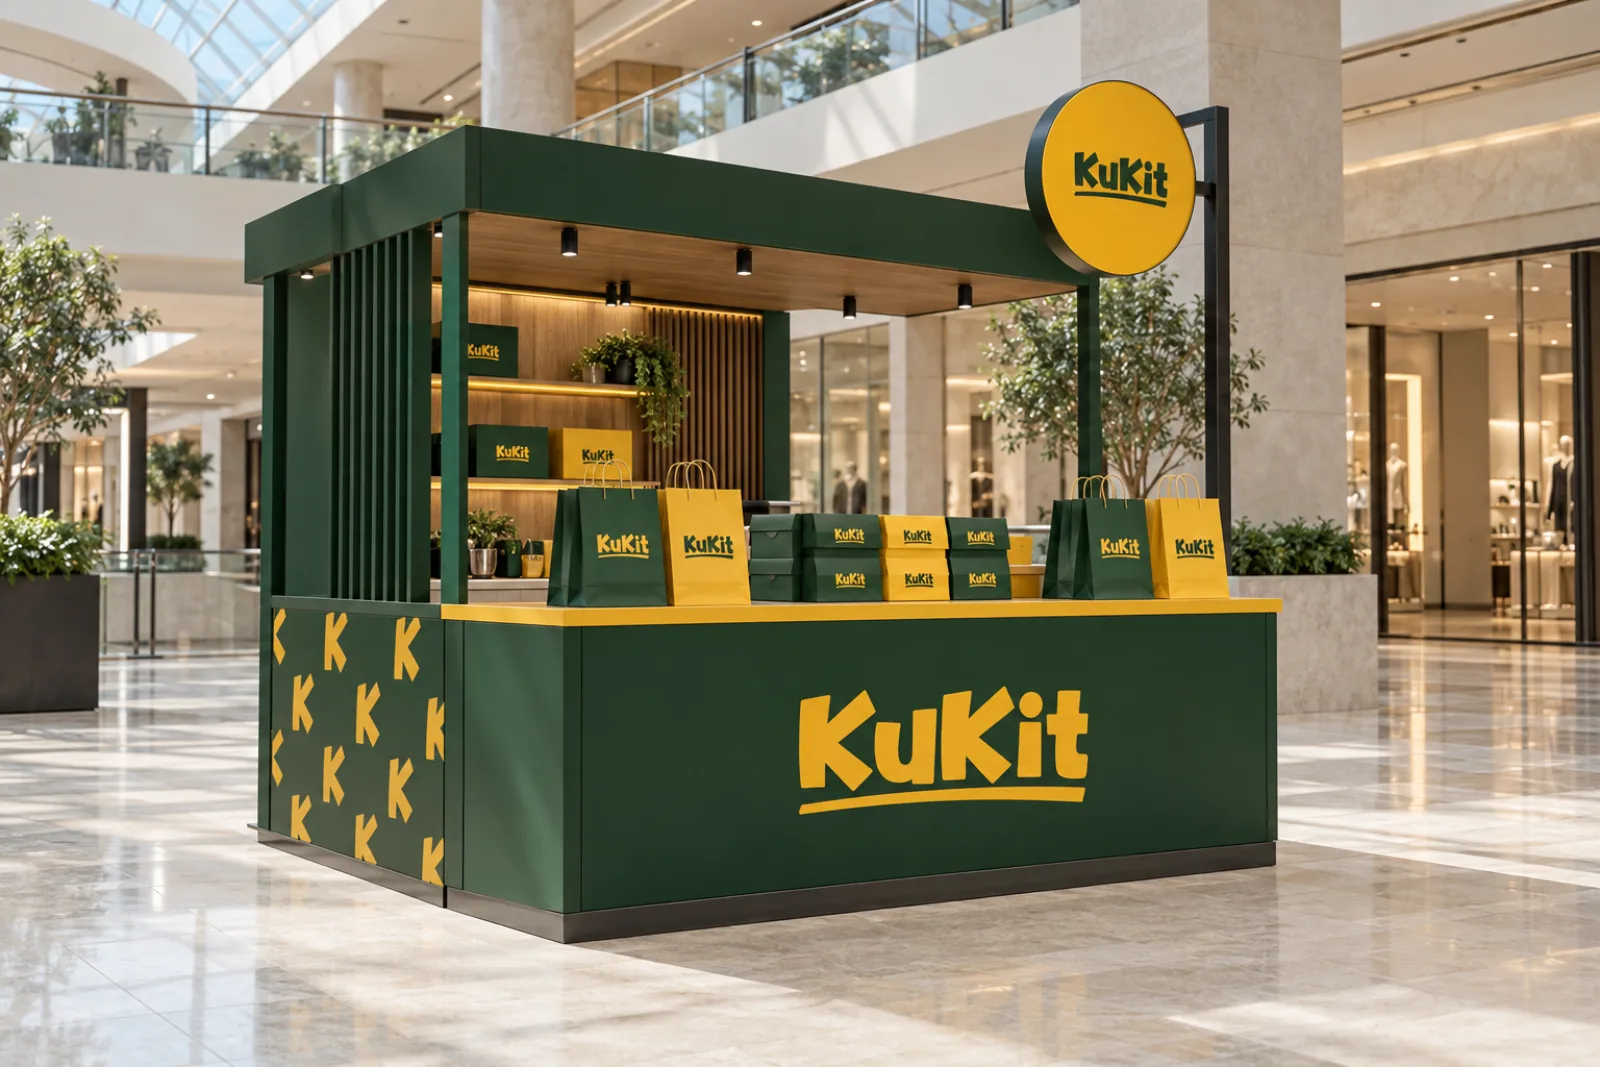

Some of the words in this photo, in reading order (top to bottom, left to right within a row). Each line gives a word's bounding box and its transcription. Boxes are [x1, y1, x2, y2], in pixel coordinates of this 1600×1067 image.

[1074, 152, 1168, 199] KuKit
[468, 343, 500, 358] KuKit
[496, 445, 530, 459] KuKit
[582, 448, 614, 461] KuKit
[597, 534, 650, 554] KuKit
[834, 527, 865, 541] KuKit
[903, 530, 932, 542] KuKit
[967, 531, 995, 543] KuKit
[684, 535, 734, 554] KuKit
[1101, 537, 1141, 555] KuKit
[1176, 539, 1215, 556] KuKit
[835, 573, 866, 586] KuKit
[905, 573, 934, 585] KuKit
[969, 572, 997, 585] KuKit
[324, 612, 348, 673] K
[394, 617, 421, 682] K
[292, 673, 315, 734] K
[356, 682, 381, 748] K
[426, 697, 445, 761] K
[799, 686, 1089, 791] KuKit
[323, 745, 345, 806] K
[388, 757, 414, 823] K
[290, 794, 312, 843] K
[355, 813, 379, 865] K
[421, 836, 445, 887] K
